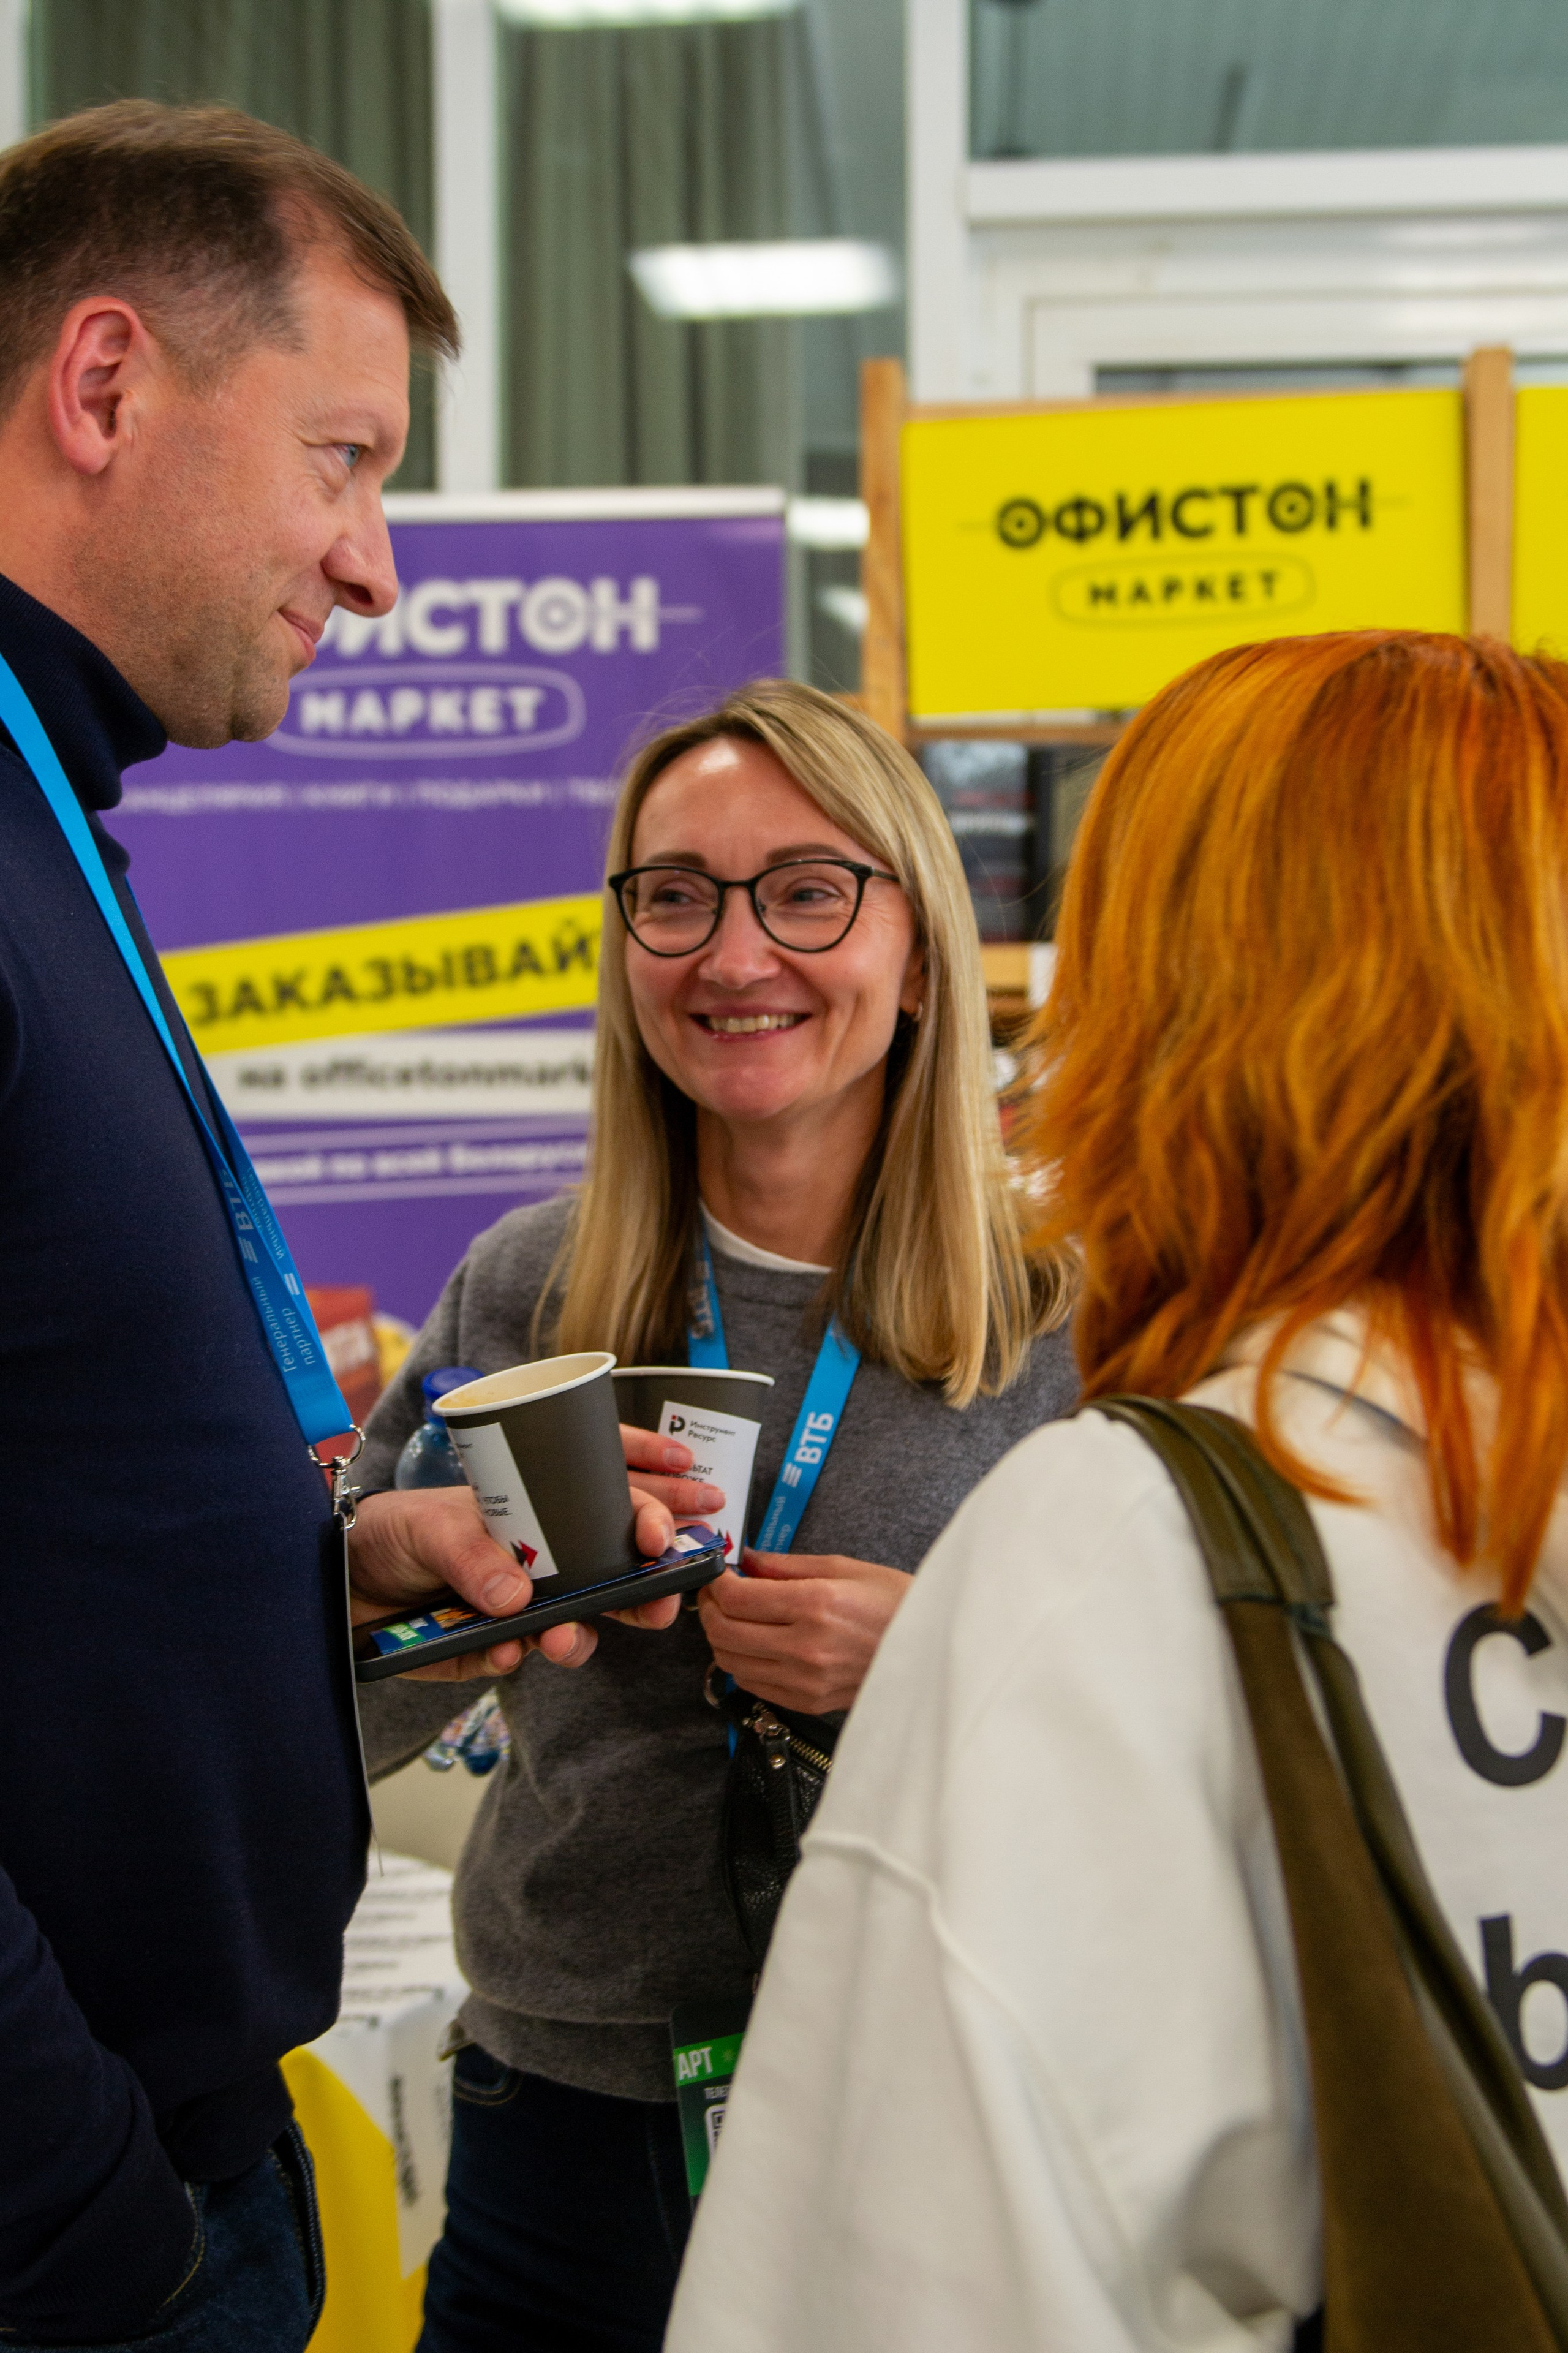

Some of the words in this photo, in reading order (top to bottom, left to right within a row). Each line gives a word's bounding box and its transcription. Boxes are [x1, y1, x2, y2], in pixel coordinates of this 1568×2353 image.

[995, 478, 1372, 550] ОФИСТОН
[1087, 570, 1281, 609] МАРКЕТ
[314, 576, 660, 658] ИСТОН
[300, 687, 543, 735] МАРКЕТ
[186, 917, 597, 1029] ЗАКАЗЫВАЙ
[251, 1276, 297, 1373] Генеральный
[282, 1307, 316, 1365] партнер
[688, 1430, 717, 1443] Ресурс
[690, 1420, 736, 1437] Инструмент
[794, 1411, 834, 1465] ВТБ
[690, 1464, 713, 1476] ЬТАТ
[677, 2045, 713, 2081] АРТ
